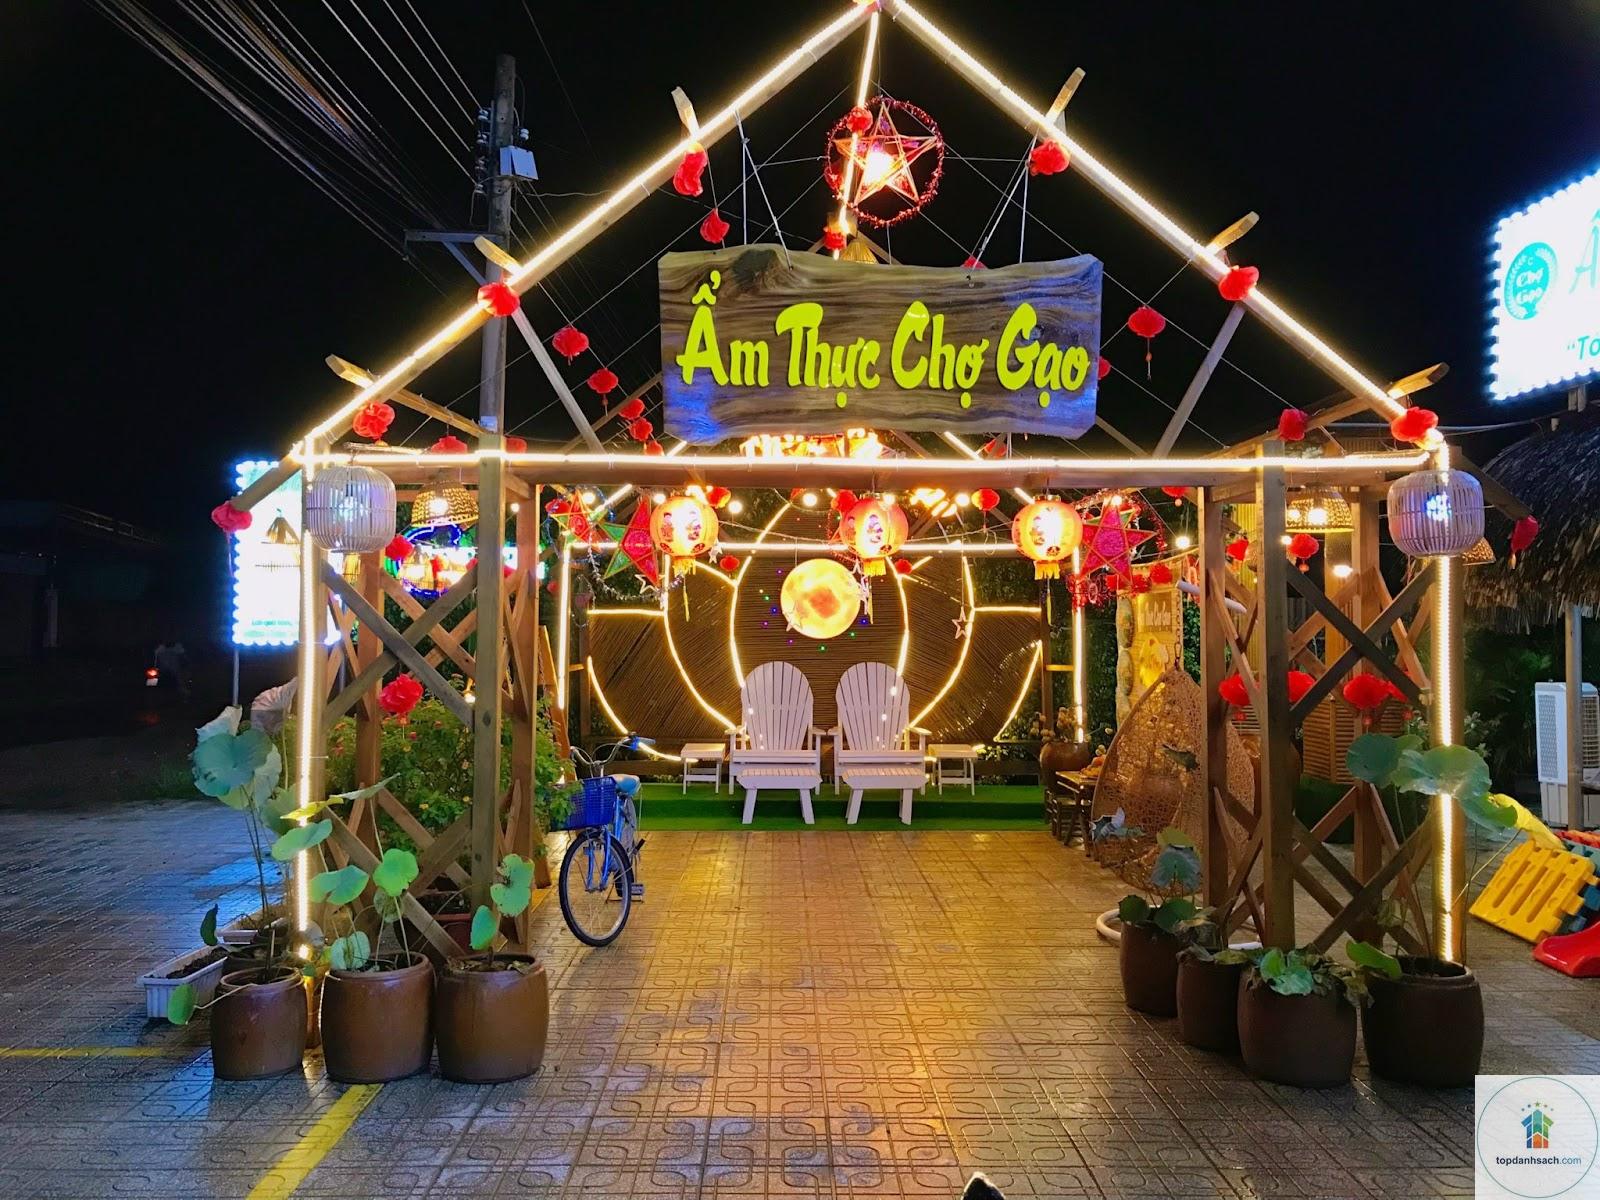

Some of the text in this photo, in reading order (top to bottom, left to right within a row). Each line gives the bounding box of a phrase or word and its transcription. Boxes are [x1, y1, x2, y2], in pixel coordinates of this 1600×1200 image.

[676, 270, 1090, 408] Ẩm Thực Chợ Gạo
